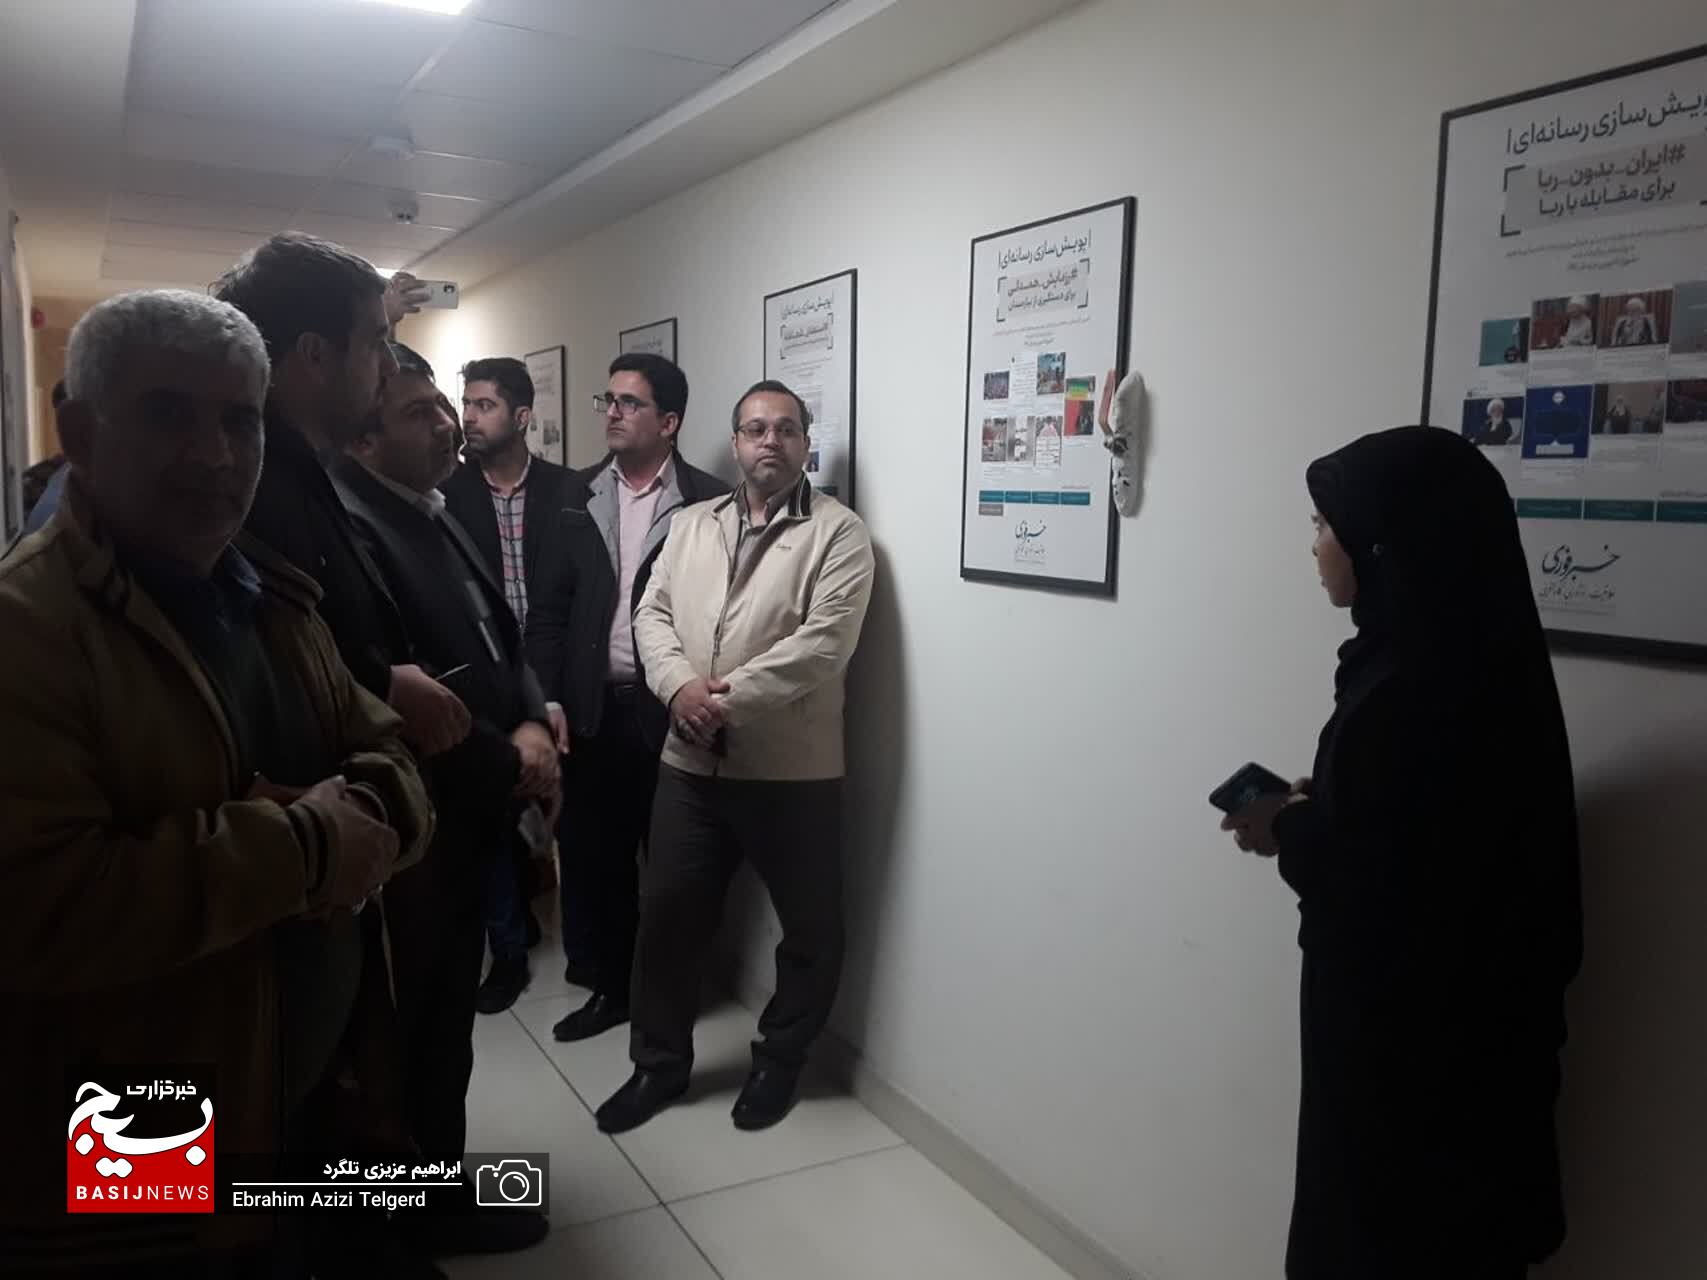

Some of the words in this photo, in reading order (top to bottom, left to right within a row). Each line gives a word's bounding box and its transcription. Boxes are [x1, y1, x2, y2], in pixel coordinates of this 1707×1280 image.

[1513, 117, 1589, 154] رسانه‌ای
[1537, 143, 1687, 192] #ایران_بدون_ربا
[1581, 184, 1639, 210] مقابله
[1641, 176, 1676, 202] برای
[1538, 197, 1565, 217] ربا
[1567, 193, 1578, 215] با
